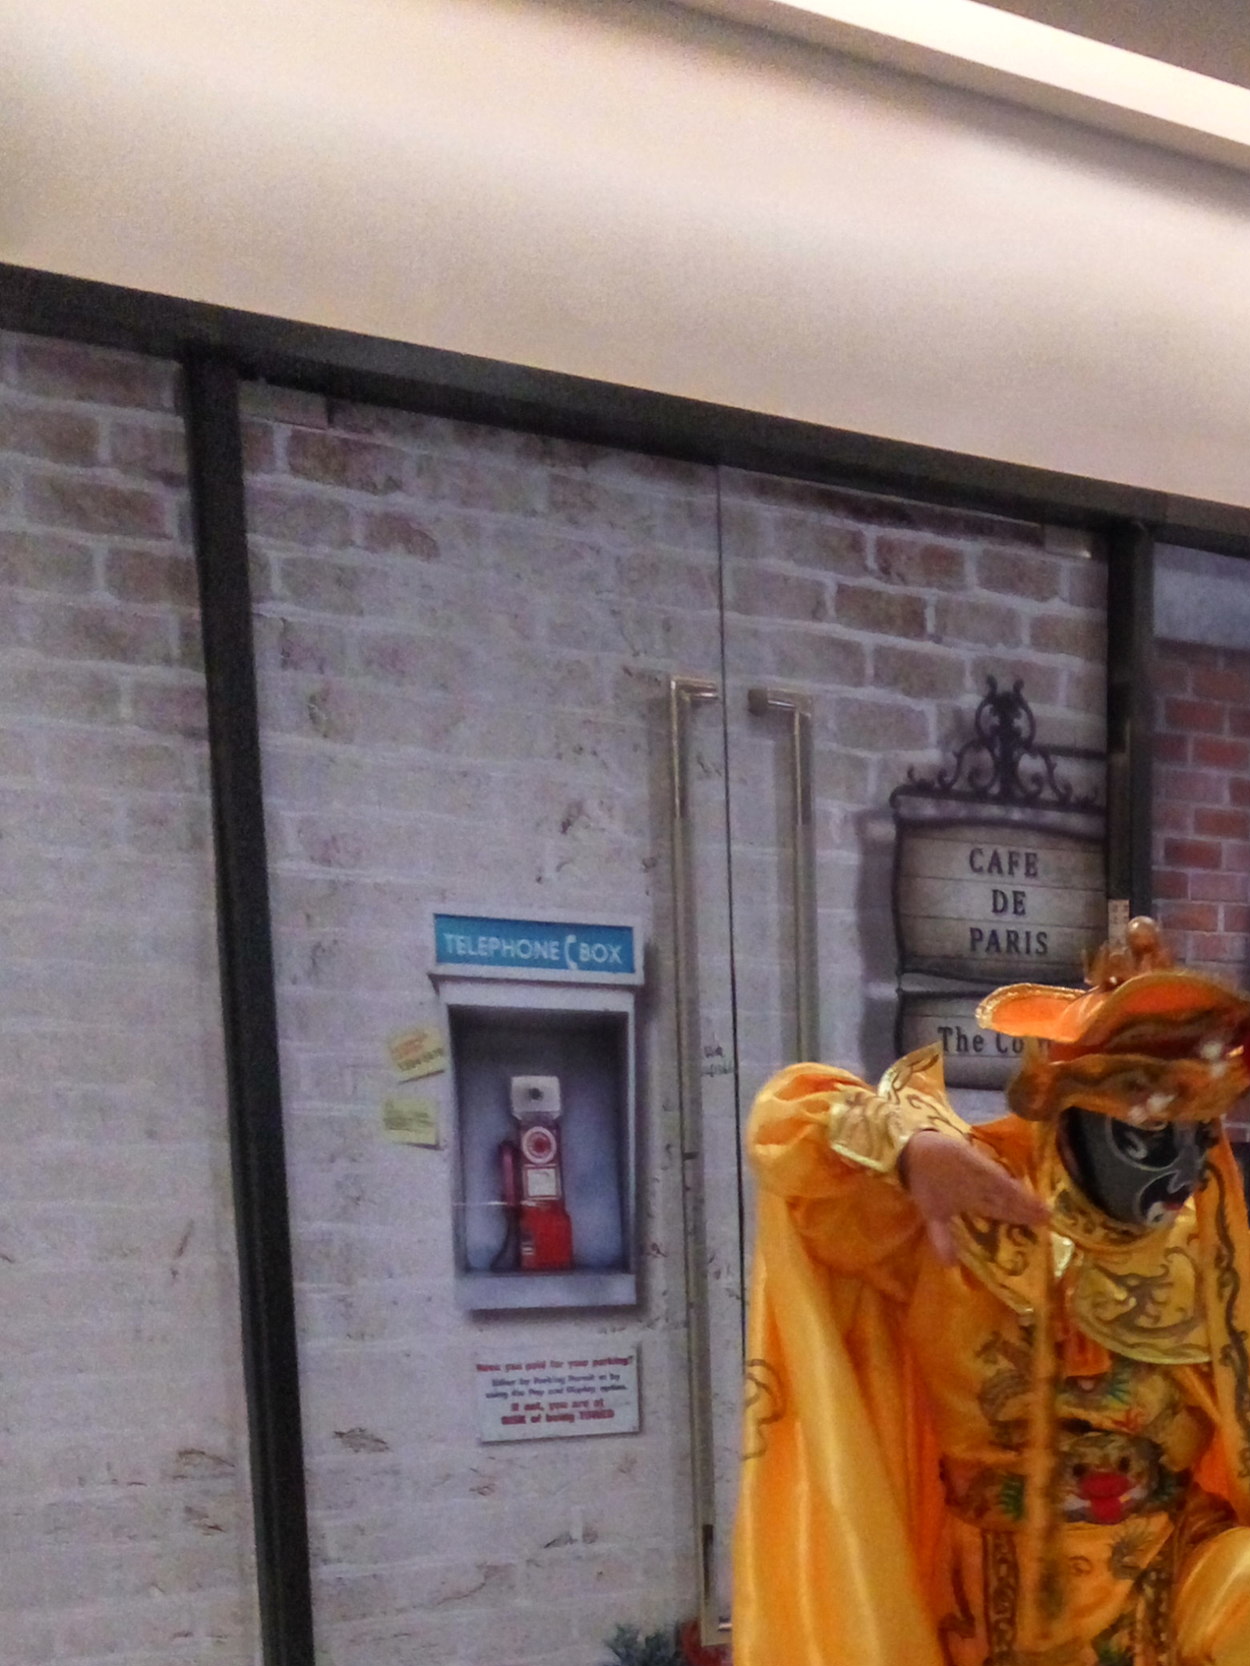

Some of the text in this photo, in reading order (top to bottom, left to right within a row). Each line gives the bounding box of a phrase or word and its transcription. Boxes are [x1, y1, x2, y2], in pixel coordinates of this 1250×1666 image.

[968, 847, 1039, 878] CAFE
[991, 888, 1027, 916] DE
[444, 932, 623, 965] TELEPHONE BOX
[969, 926, 1049, 955] PARIS
[937, 1026, 984, 1053] The
